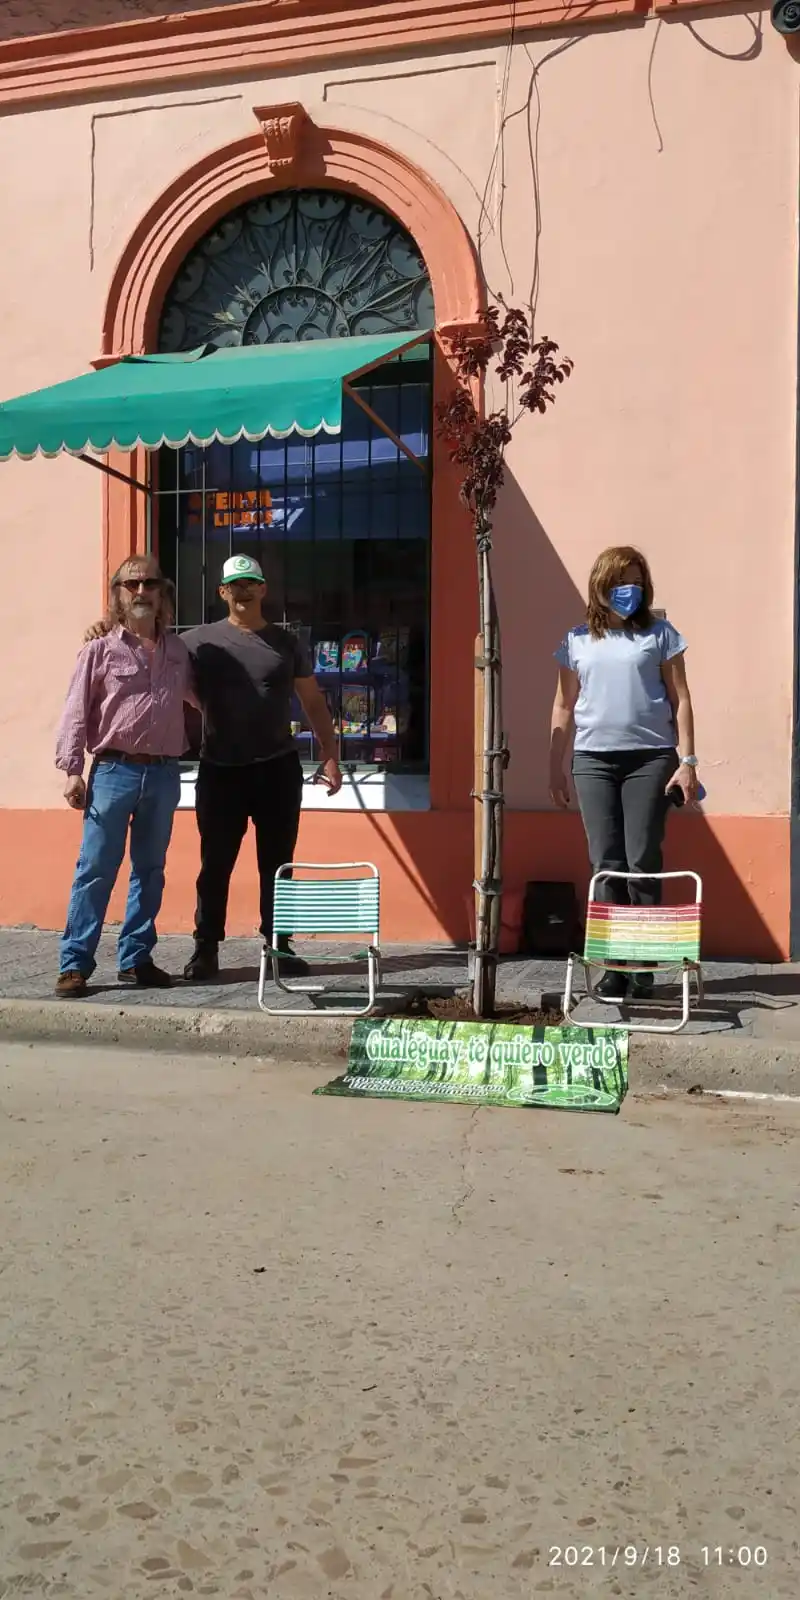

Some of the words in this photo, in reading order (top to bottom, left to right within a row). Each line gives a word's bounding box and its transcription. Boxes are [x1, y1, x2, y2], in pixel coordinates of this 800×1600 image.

[366, 1027, 463, 1070] Gualeguay
[491, 1034, 555, 1071] quiero
[559, 1036, 618, 1069] verde
